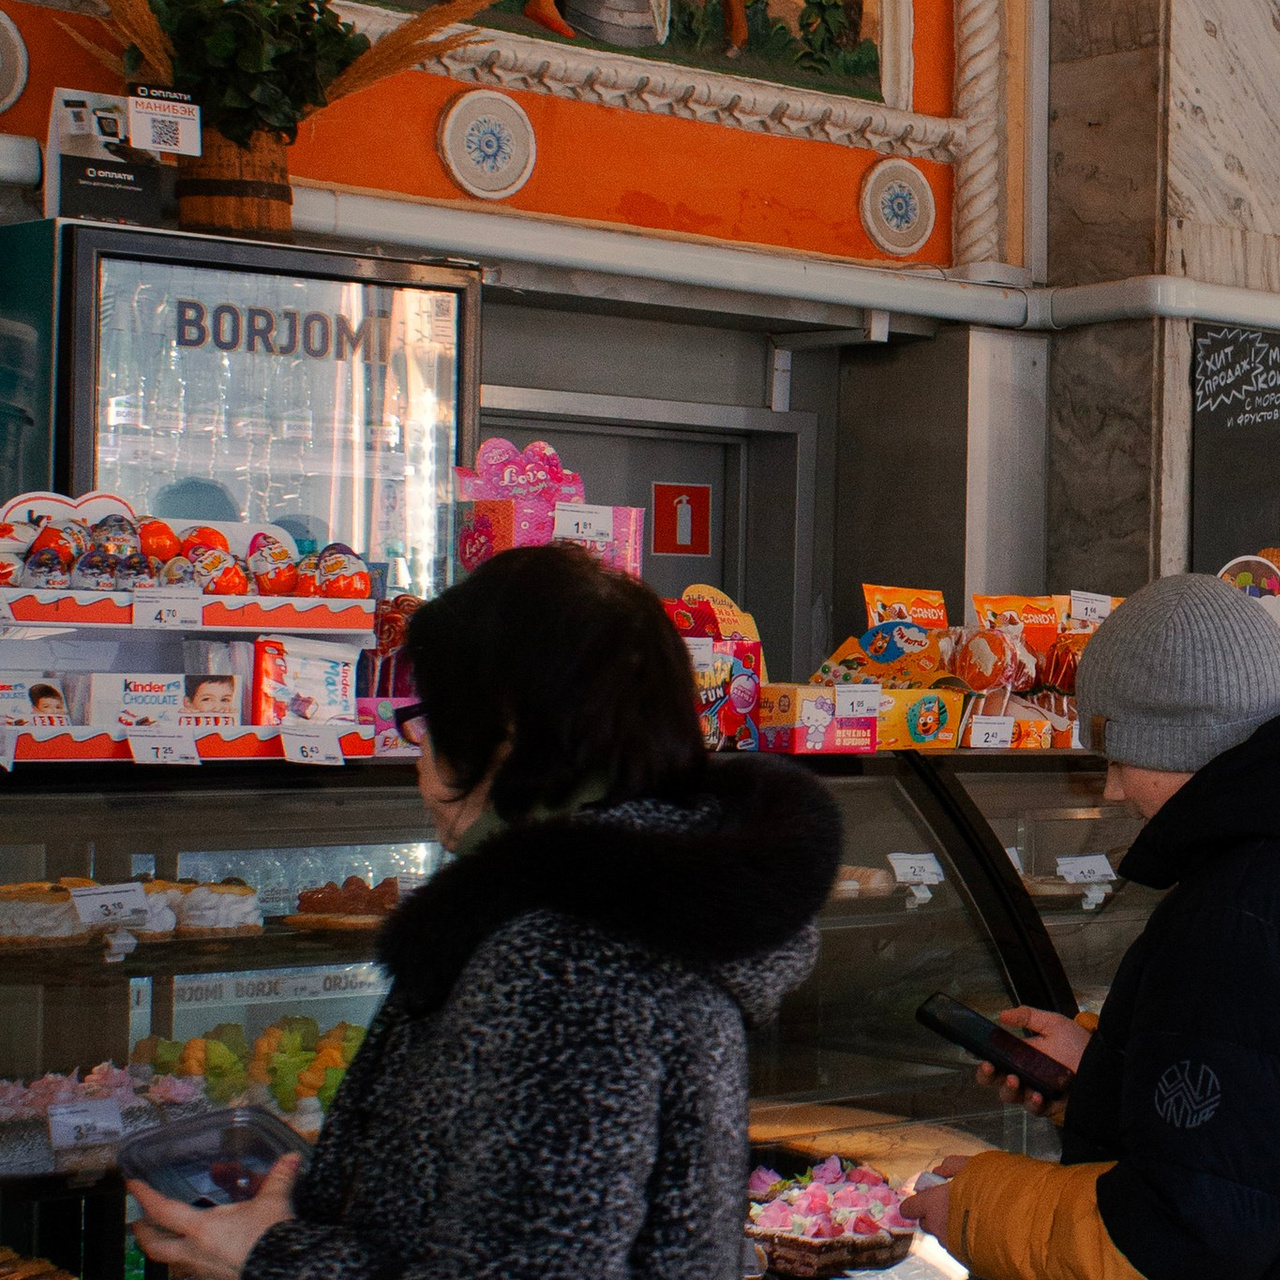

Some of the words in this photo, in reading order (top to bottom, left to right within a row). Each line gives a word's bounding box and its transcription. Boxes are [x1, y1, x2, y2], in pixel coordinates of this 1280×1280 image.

[150, 87, 192, 101] ОПЛАТИ
[134, 100, 196, 117] МАНИБЭК
[97, 170, 135, 181] ОПЛАТИ
[1205, 346, 1234, 376] ХИТ
[910, 606, 944, 620] CANDY
[1021, 612, 1056, 625] CANDY
[123, 678, 165, 693] Kinder
[341, 661, 351, 698] Kinder
[123, 694, 178, 705] CHOCOLATE
[700, 686, 724, 704] FUN
[836, 729, 871, 737] ПЕЧЕНЬЕ
